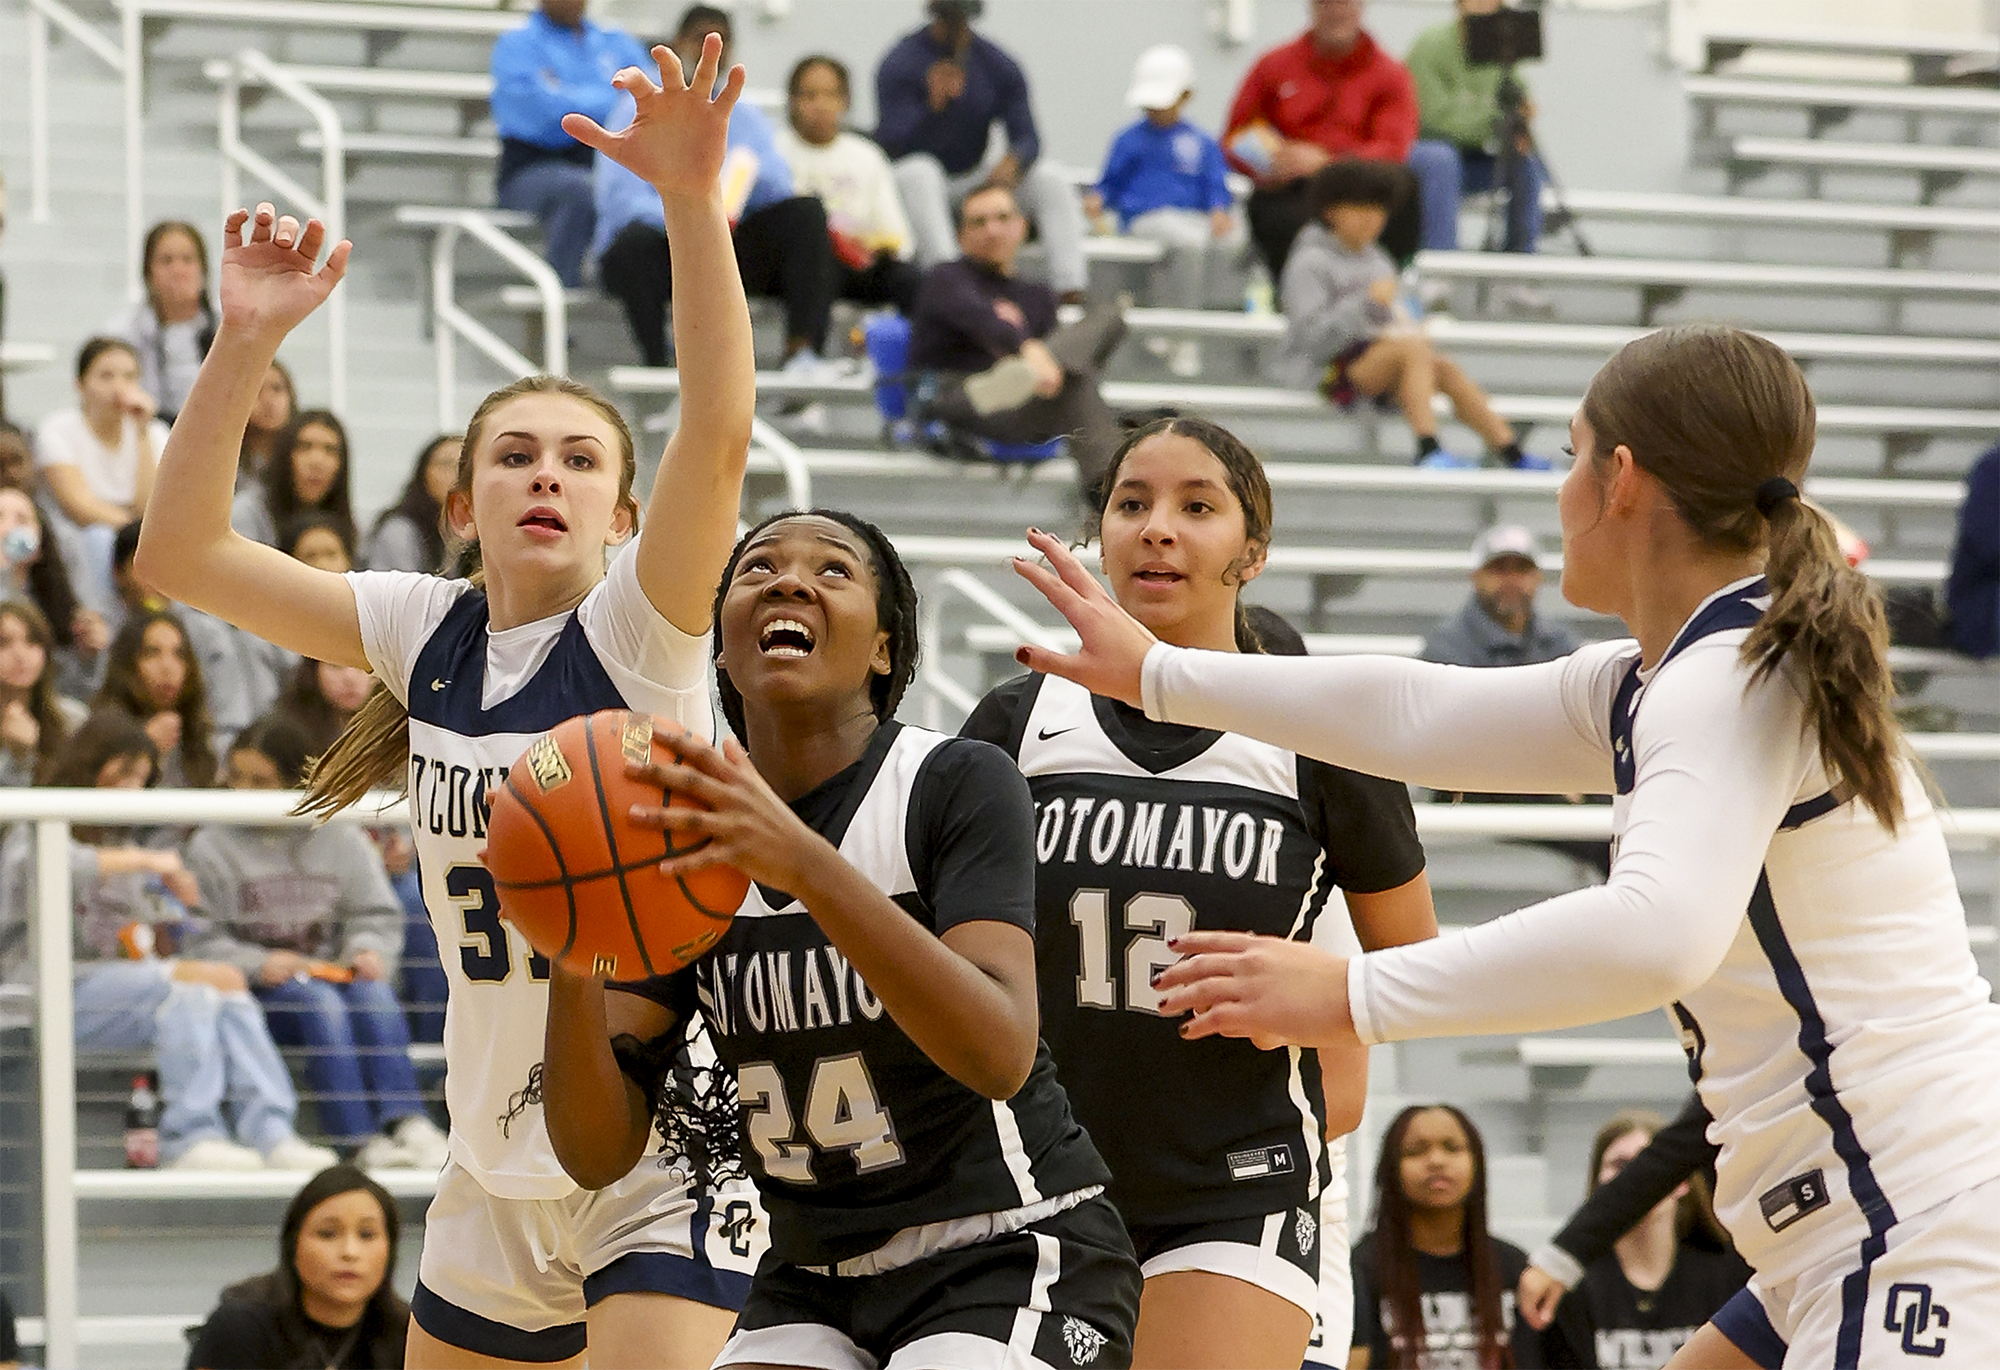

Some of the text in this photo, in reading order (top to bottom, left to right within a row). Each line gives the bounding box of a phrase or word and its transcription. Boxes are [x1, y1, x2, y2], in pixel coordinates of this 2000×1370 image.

[1034, 797, 1284, 886] OTOMAYOR
[1069, 888, 1197, 1017] 12
[738, 1051, 906, 1185] 24
[1273, 1152, 1287, 1167] M
[1800, 1183, 1815, 1201] S
[1884, 1283, 1950, 1358] OC
